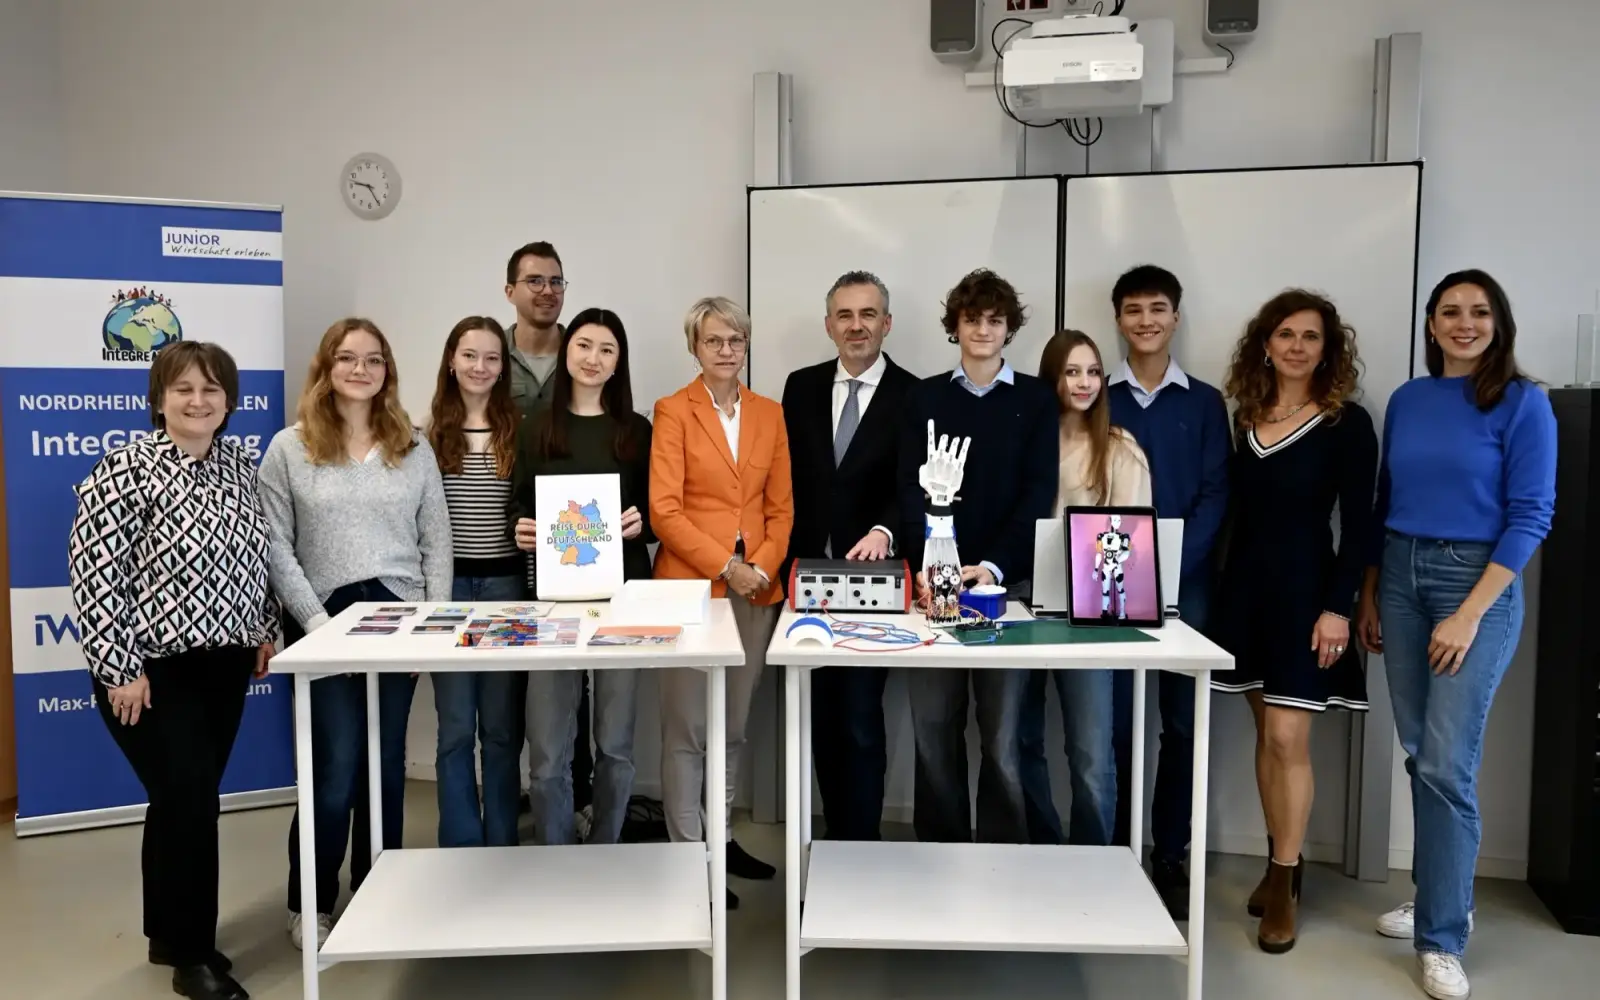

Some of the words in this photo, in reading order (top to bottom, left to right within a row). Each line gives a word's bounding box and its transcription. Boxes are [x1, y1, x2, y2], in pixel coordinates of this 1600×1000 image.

[171, 245, 231, 256] Wirtschaft
[234, 248, 272, 257] erleben
[102, 347, 157, 362] InteGREA
[550, 522, 574, 531] REISE
[577, 521, 608, 531] DURCH
[547, 534, 612, 545] DEUTSCHLAND
